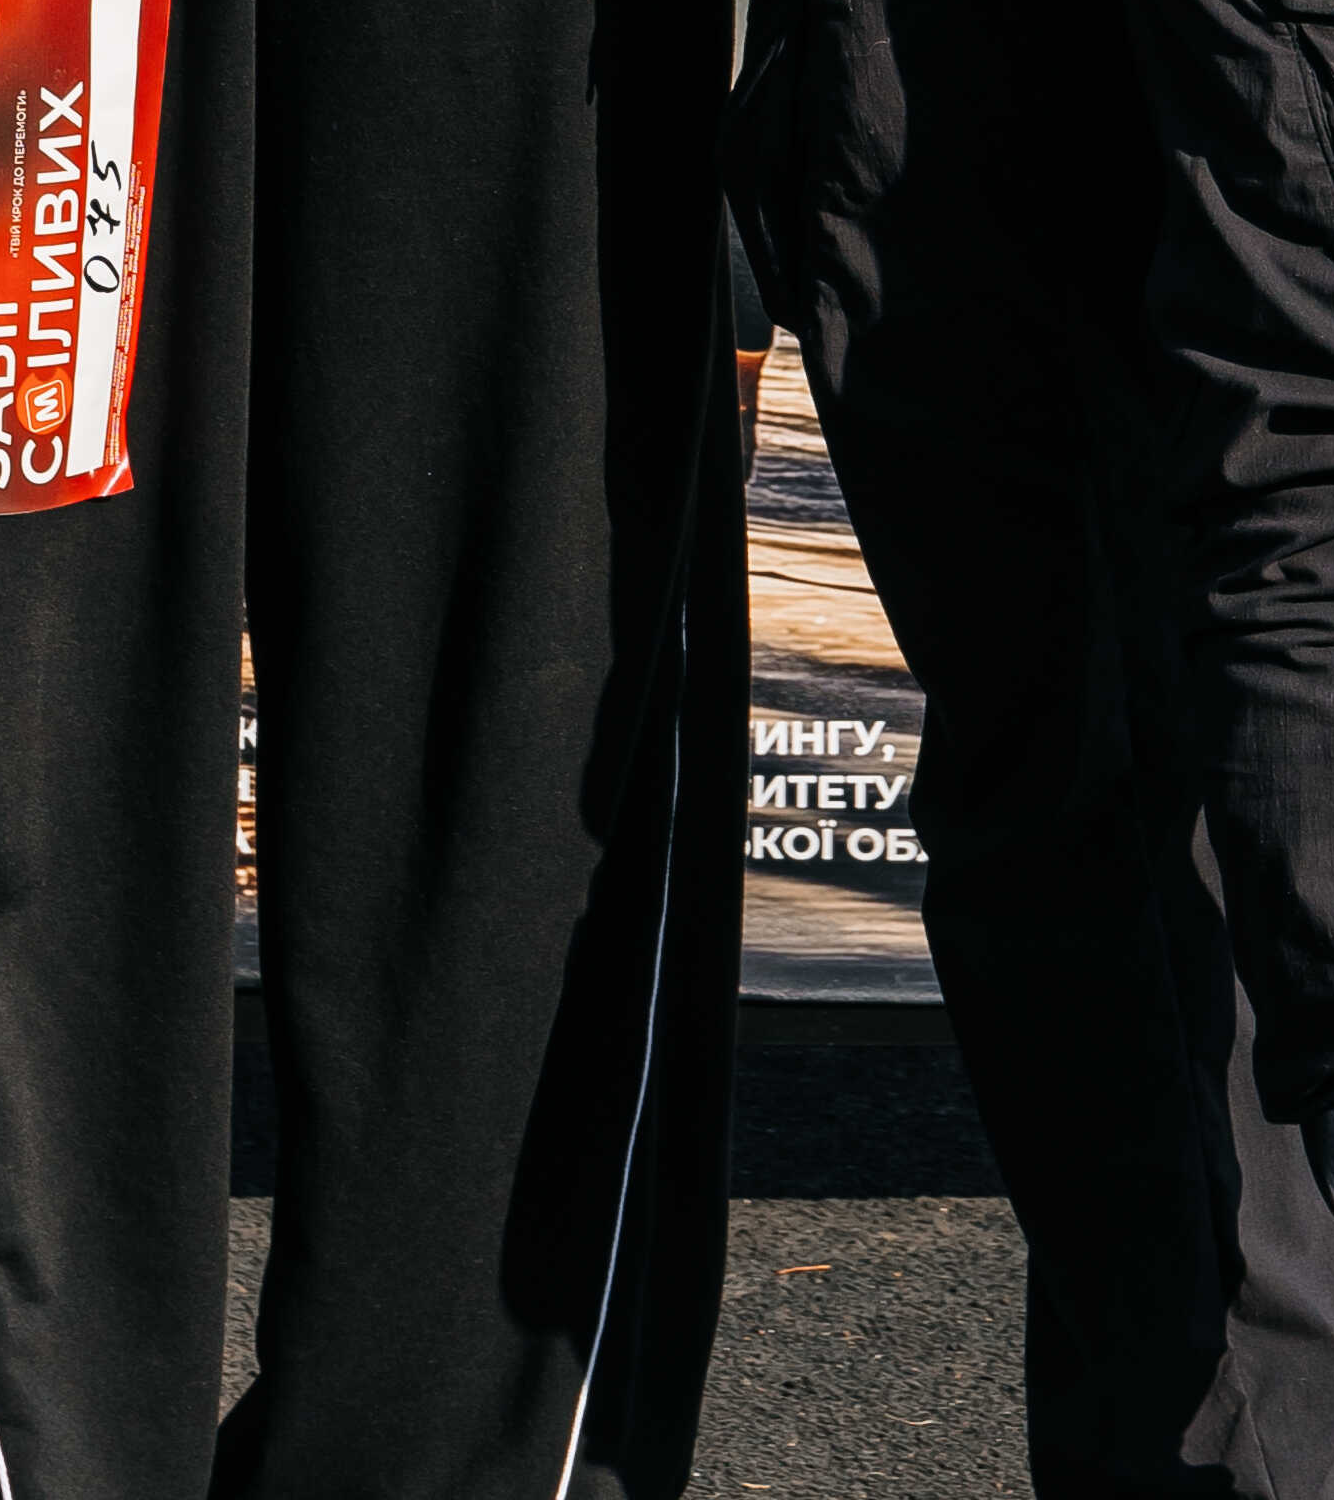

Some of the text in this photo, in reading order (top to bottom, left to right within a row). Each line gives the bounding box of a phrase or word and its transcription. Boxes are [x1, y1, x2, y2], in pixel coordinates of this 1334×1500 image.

[10, 90, 27, 258] «ТВІЙ КРОК ДО ПЕРЕМОГИ»
[749, 720, 896, 762] ИНГУ,
[749, 774, 908, 810] ИТЕТУ
[745, 819, 838, 861] КОЇ
[847, 828, 929, 862] ОБ
